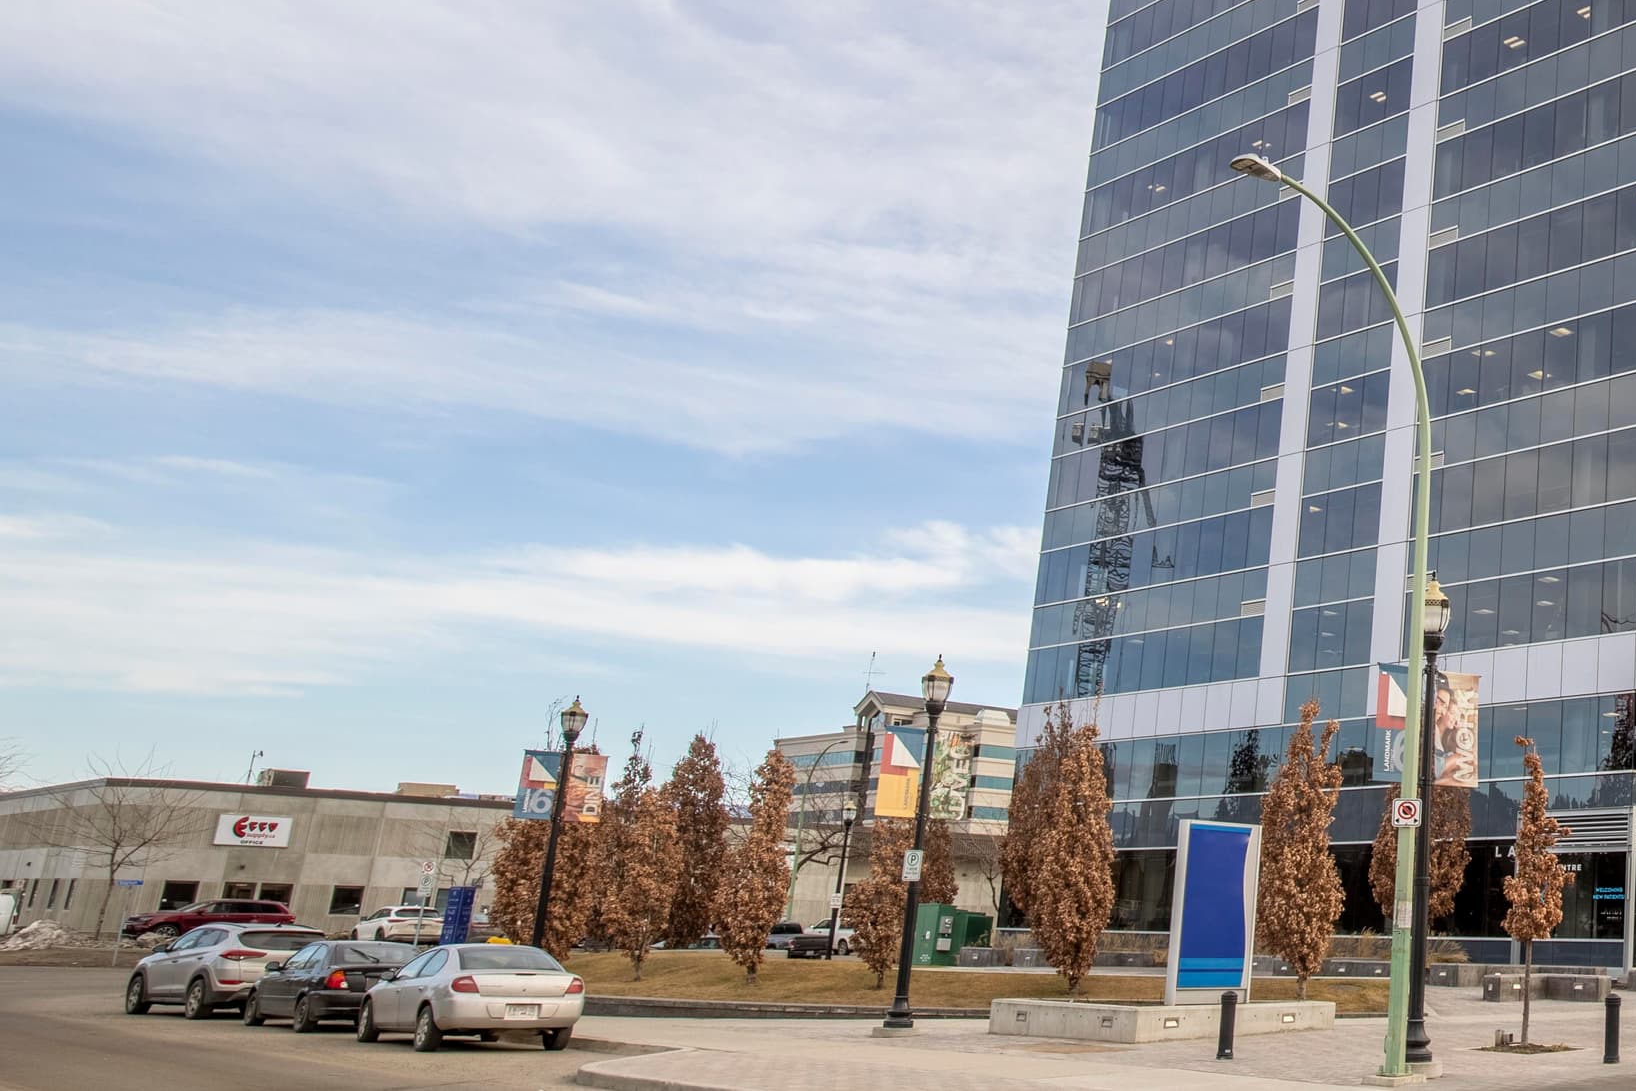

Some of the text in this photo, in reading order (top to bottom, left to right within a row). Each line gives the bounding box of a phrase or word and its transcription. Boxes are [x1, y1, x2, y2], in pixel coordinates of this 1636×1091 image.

[1383, 730, 1392, 772] LANDMARK
[1453, 690, 1475, 781] WORK
[582, 777, 601, 815] DINE
